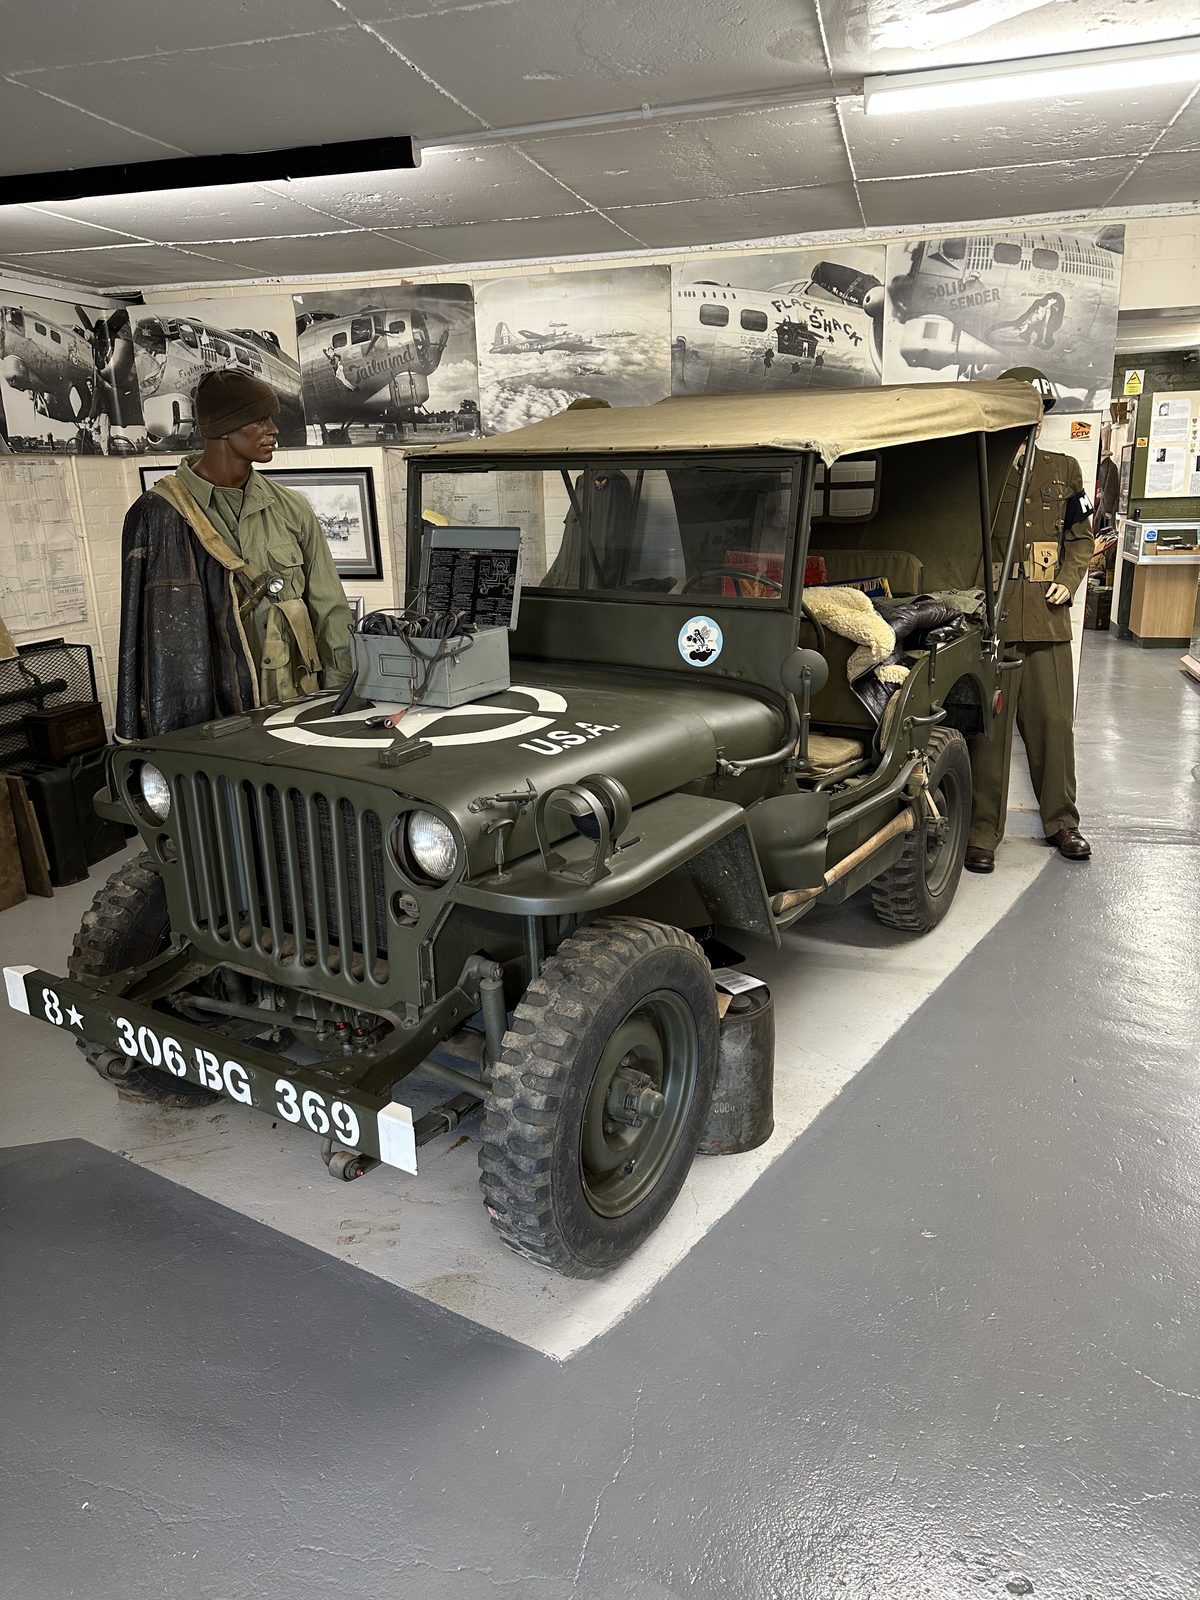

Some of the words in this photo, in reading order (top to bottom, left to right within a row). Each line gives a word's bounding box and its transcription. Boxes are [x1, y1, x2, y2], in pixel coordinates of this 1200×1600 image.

[928, 280, 967, 300] SOLID
[950, 288, 1001, 311] SENDER
[771, 298, 825, 317] FLACK
[809, 315, 863, 347] SHACK
[348, 343, 415, 384] Tailwind
[1071, 430, 1090, 438] CCTV
[518, 722, 621, 756] U.S.A.
[42, 987, 64, 1026] 8
[115, 1016, 188, 1078] 306
[194, 1047, 253, 1106] BG
[274, 1078, 361, 1147] 369
